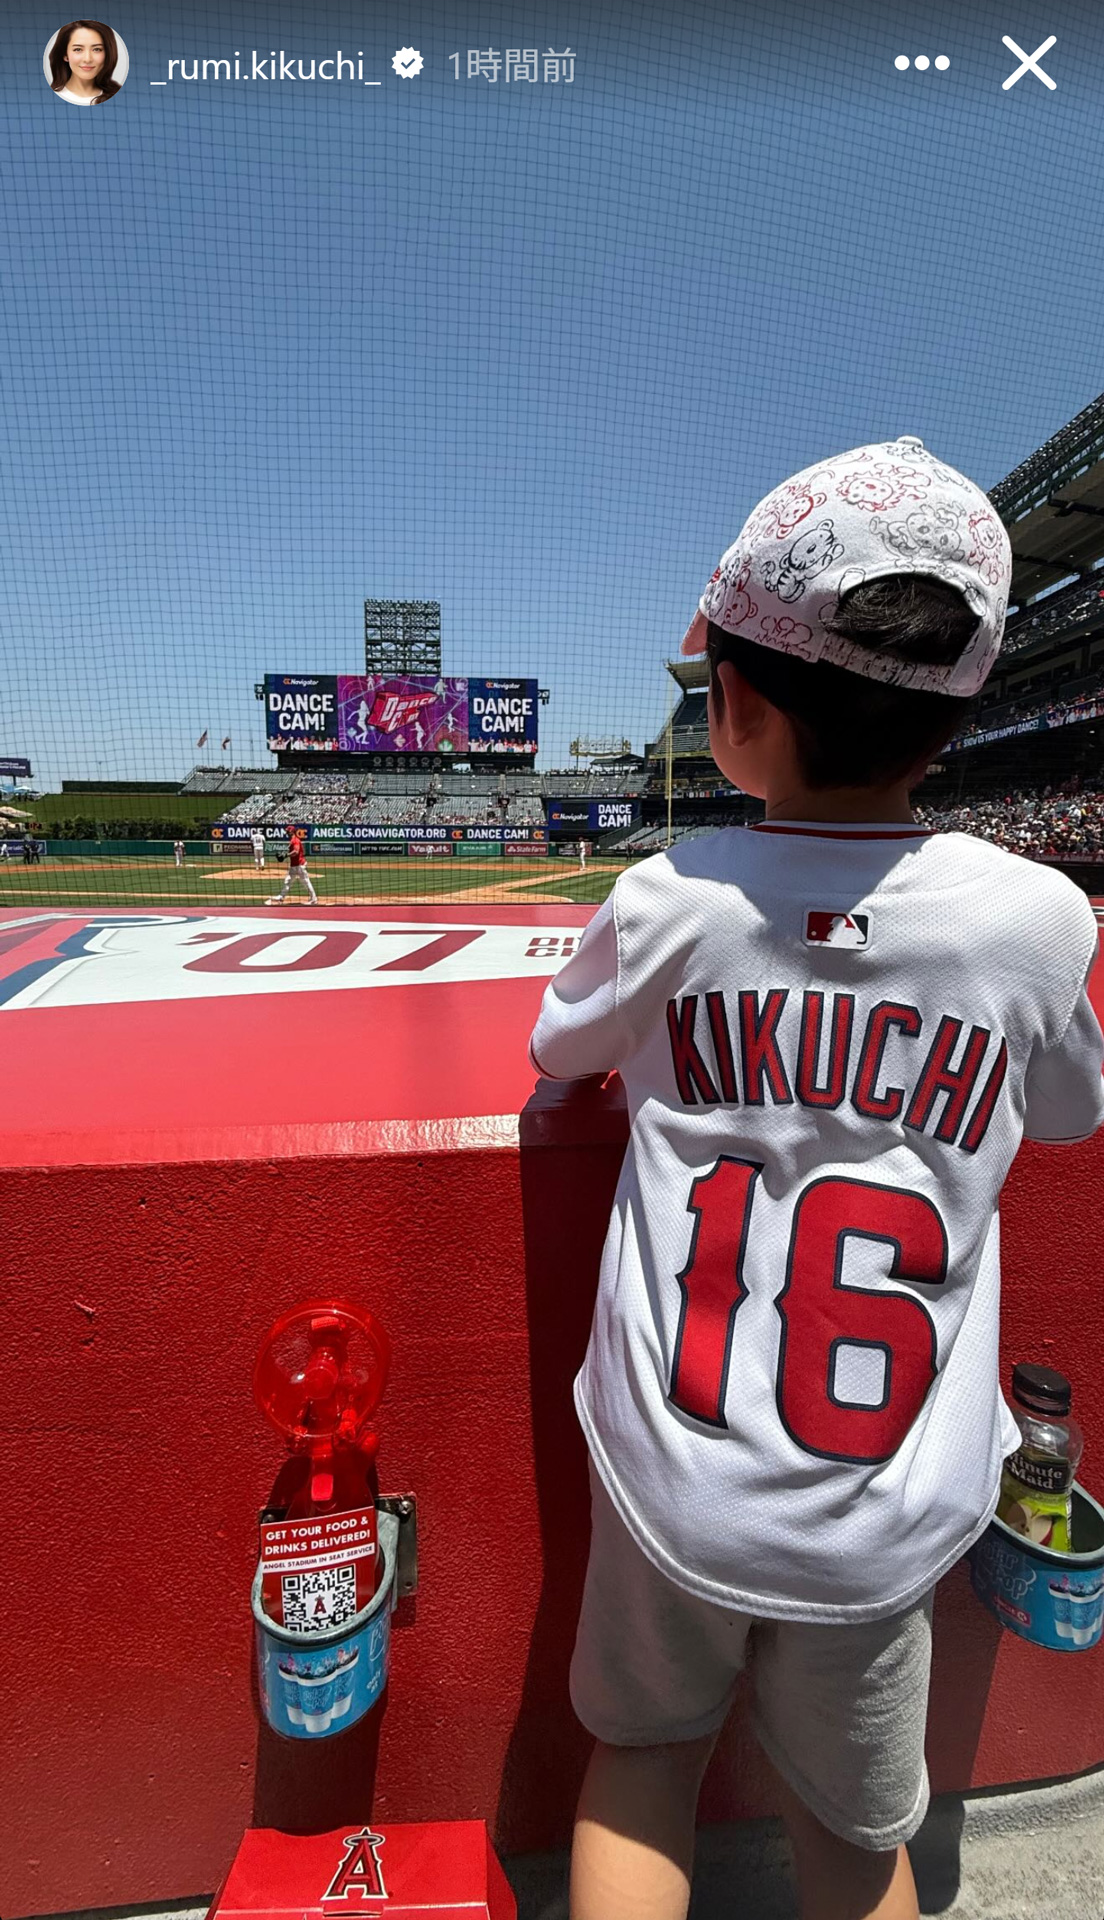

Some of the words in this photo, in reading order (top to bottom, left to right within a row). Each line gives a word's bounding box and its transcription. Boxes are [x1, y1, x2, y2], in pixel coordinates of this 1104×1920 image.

[269, 693, 334, 712] DANCE
[473, 697, 533, 715] DANCE
[279, 712, 326, 731] CAM!
[481, 715, 525, 733] CAM!
[985, 731, 998, 742] YOUR
[999, 726, 1017, 738] HAPPY
[1017, 719, 1039, 735] DANCE!
[598, 804, 632, 814] DANCE
[598, 814, 632, 828] CAM!
[227, 827, 264, 838] DANCE
[313, 827, 447, 839] ANGELS.OCNAVIGATOR.ORG
[467, 829, 502, 839] DANCE
[503, 829, 529, 839] CAM!
[412, 845, 450, 853] Yault
[528, 937, 581, 946] DI
[667, 988, 1008, 1154] KIKUCHI
[668, 1154, 949, 1466] 16
[1007, 1462, 1054, 1490] Maid
[266, 1530, 287, 1541] GET
[291, 1525, 322, 1538] YOUR
[326, 1518, 358, 1533] FOOD
[360, 1516, 369, 1526] &
[265, 1542, 308, 1556] DRINKS
[311, 1529, 371, 1550] DELIVERED!
[288, 1558, 317, 1568] STADIUM
[329, 1553, 345, 1561] SEAT
[347, 1545, 373, 1557] SERVICE
